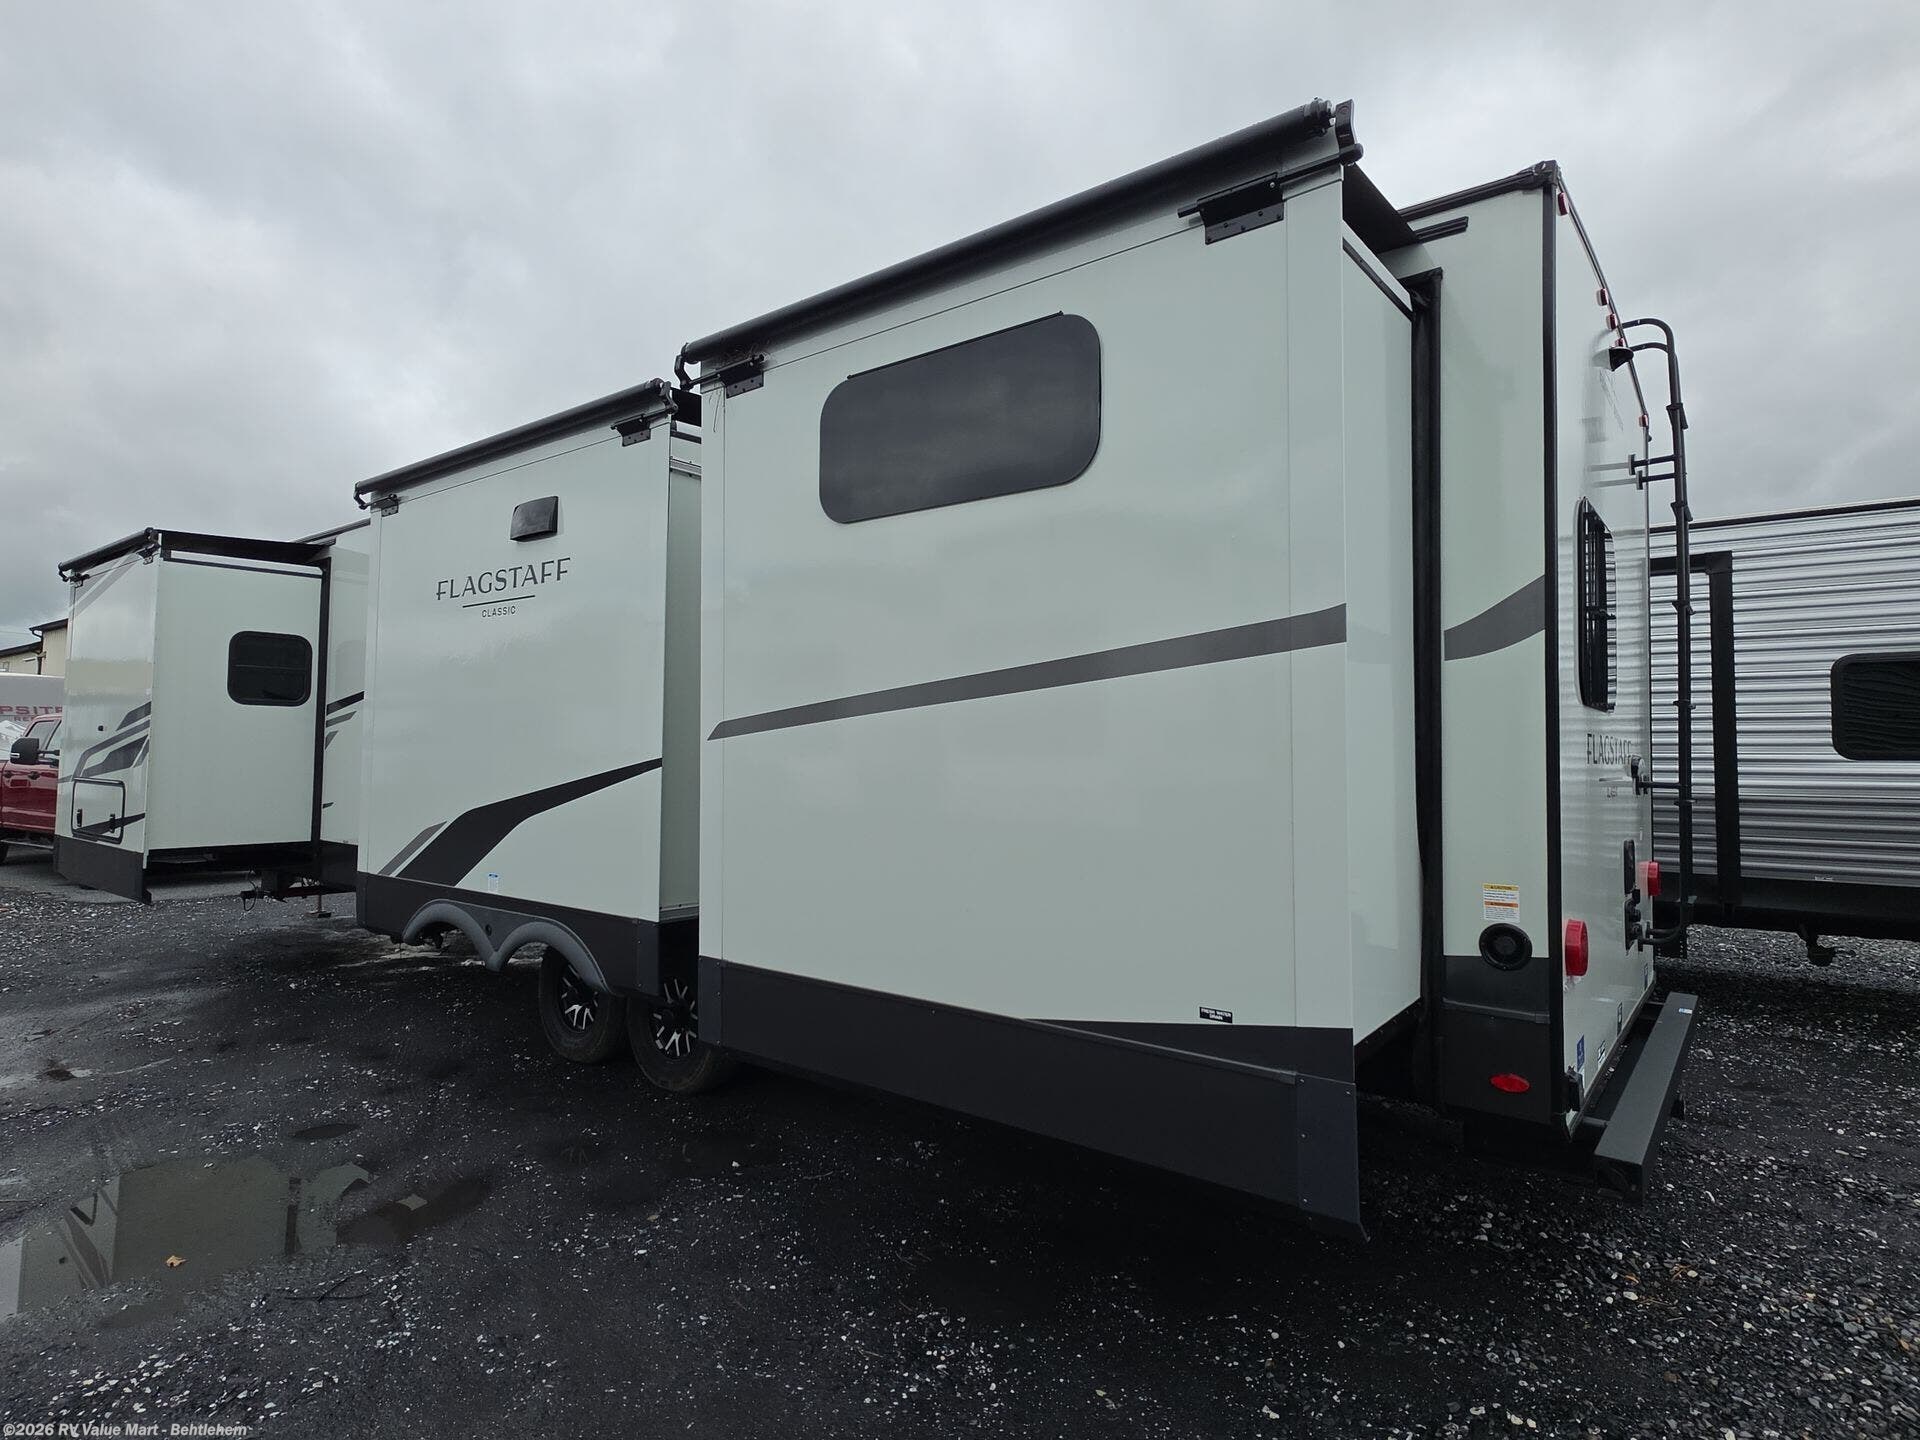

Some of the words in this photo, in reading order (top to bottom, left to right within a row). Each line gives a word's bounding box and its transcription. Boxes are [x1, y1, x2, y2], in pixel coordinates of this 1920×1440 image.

[436, 557, 571, 601] FLAGSTAFF
[481, 605, 517, 618] CLASSIC
[1586, 733, 1632, 765] FLAGSTAFF
